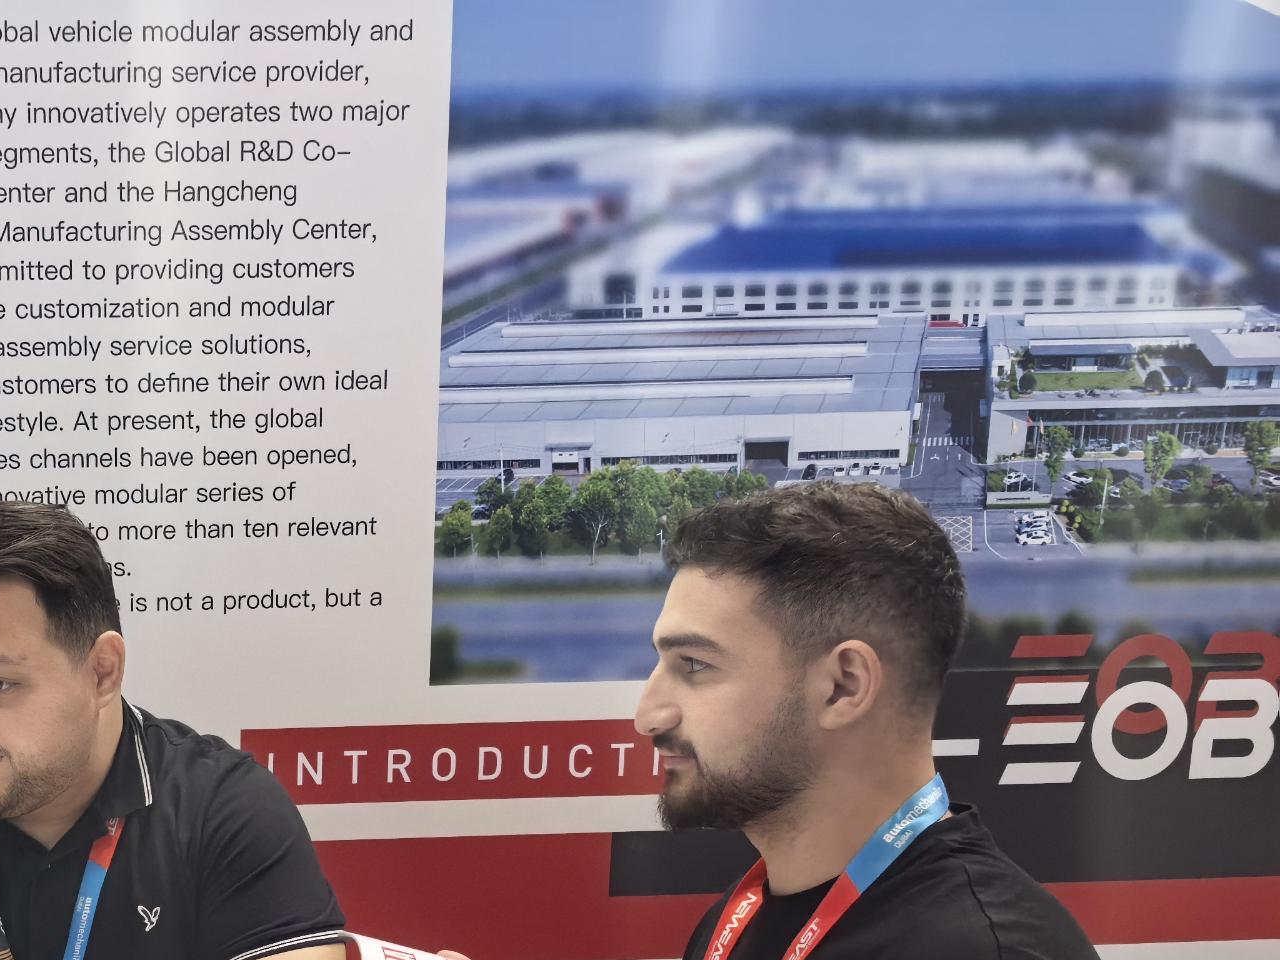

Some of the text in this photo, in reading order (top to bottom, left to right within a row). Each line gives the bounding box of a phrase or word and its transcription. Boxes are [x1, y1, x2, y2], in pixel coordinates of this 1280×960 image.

[48, 19, 133, 43] vehicle
[142, 19, 241, 43] modular
[249, 18, 361, 47] assembly
[369, 18, 414, 42] and
[171, 60, 257, 83] service
[265, 58, 369, 88] provider,
[26, 100, 167, 129] innovatively
[175, 101, 281, 129] operates
[289, 101, 333, 122] two
[342, 99, 411, 127] major
[107, 140, 146, 164] the
[155, 140, 230, 163] Global
[240, 139, 294, 163] R&D
[64, 180, 108, 203] and
[116, 180, 155, 203] the
[164, 179, 297, 208] Hangcheng
[170, 218, 284, 246] Assembly
[292, 218, 377, 244] Center,
[81, 260, 106, 281] to
[115, 258, 224, 286] providing
[232, 258, 355, 279] customers
[15, 296, 180, 320] customization
[188, 295, 231, 318] and
[240, 294, 336, 317] modular
[109, 335, 193, 357] service
[201, 333, 311, 358] solutions,
[104, 373, 129, 394] to
[137, 371, 210, 394] define
[217, 371, 271, 392] their
[278, 375, 325, 392] own
[335, 368, 388, 391] ideal
[72, 410, 99, 432] At
[107, 410, 200, 436] present,
[209, 408, 246, 429] the
[254, 406, 323, 434] global
[29, 446, 132, 470] channels
[140, 446, 194, 467] have
[202, 445, 258, 467] been
[266, 443, 357, 470] opened,
[94, 483, 188, 505] modular
[196, 482, 264, 503] series
[272, 481, 297, 501] of
[118, 522, 176, 541] more
[185, 518, 234, 539] than
[243, 518, 278, 538] ten
[288, 516, 377, 537] relevant
[129, 592, 148, 613] is
[156, 592, 193, 612] not
[201, 595, 215, 611] a
[223, 588, 317, 615] product,
[325, 587, 362, 608] but
[370, 590, 383, 607] a
[998, 679, 1280, 786] EOB
